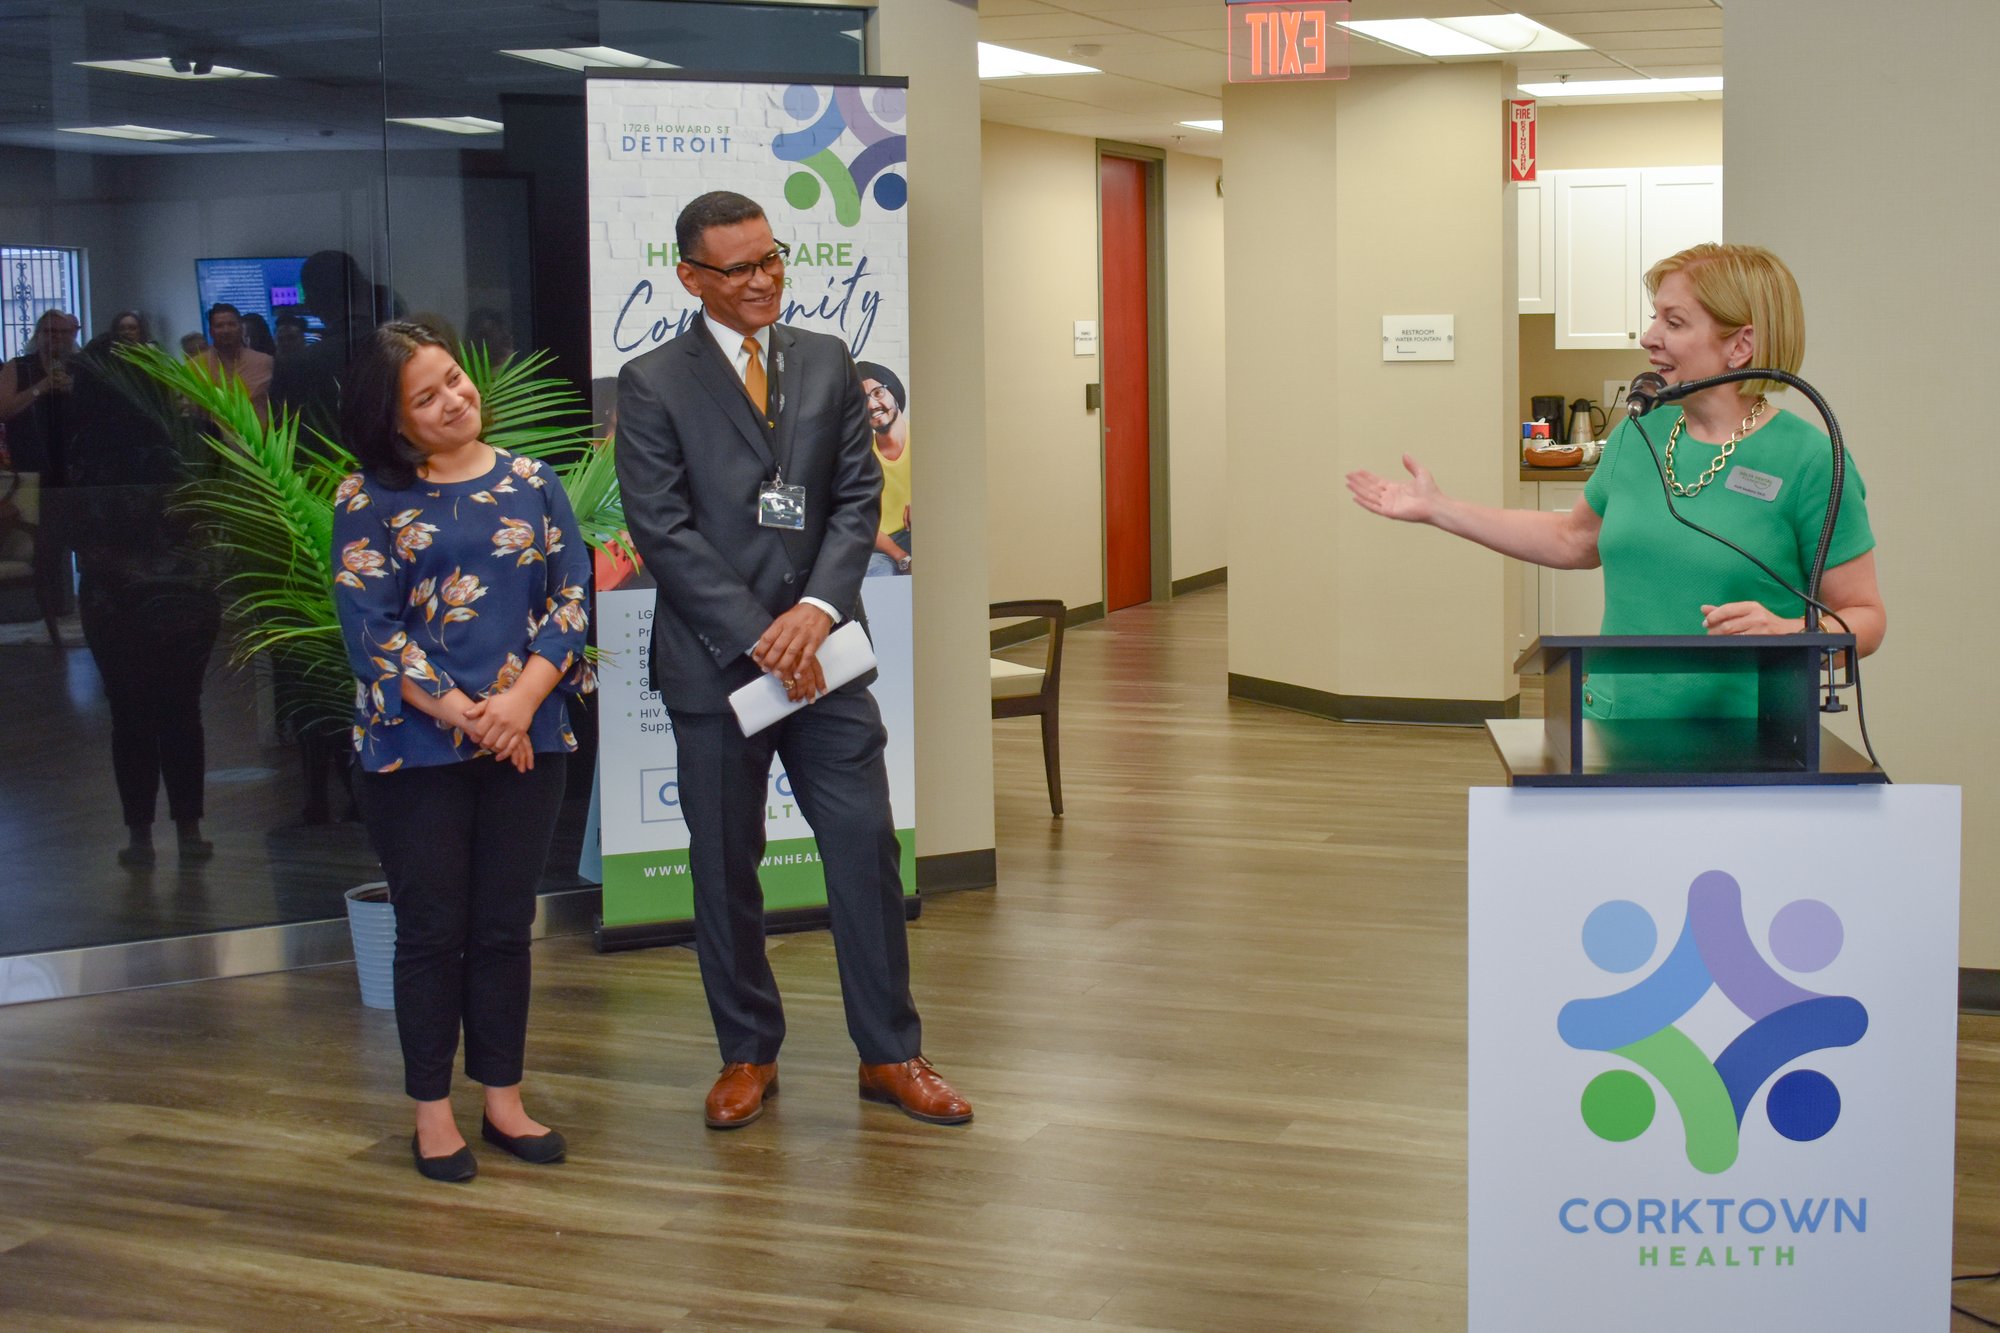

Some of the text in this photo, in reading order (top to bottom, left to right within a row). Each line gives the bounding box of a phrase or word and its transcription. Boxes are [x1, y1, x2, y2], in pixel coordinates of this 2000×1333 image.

[1515, 108, 1531, 119] FIRE
[623, 123, 730, 134] 1726 HOWARD ST
[622, 136, 731, 153] DETROIT
[647, 242, 853, 267] HEARE
[613, 256, 884, 359] Conity
[640, 707, 661, 719] HIV
[640, 722, 673, 734] Supp
[1558, 1197, 1867, 1234] CORKTOWN
[1638, 1245, 1795, 1267] HEALTH
